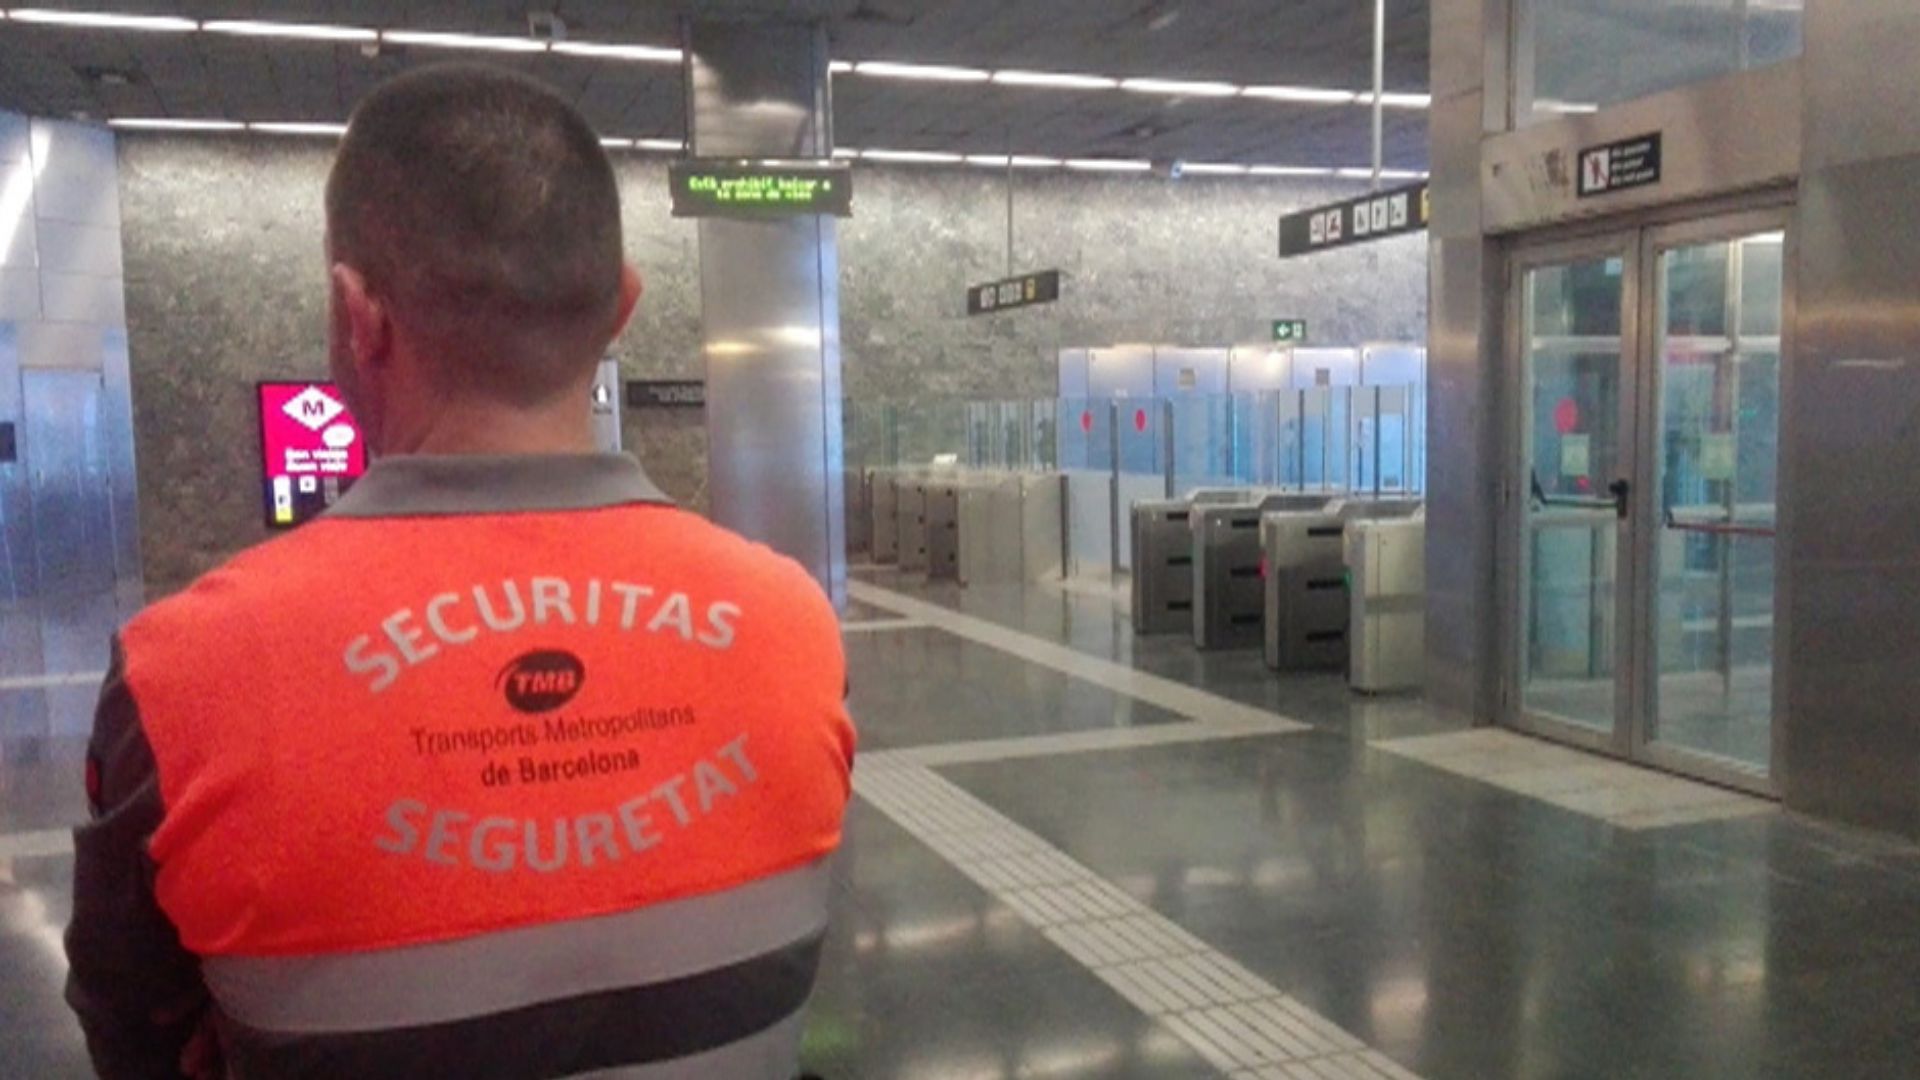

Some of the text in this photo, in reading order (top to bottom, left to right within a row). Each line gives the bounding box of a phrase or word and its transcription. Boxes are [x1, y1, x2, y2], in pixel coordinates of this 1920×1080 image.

[302, 399, 325, 416] M
[343, 576, 742, 693] SECURITAS
[515, 670, 576, 696] TMB
[411, 704, 697, 754] Transports Metropolitans
[481, 747, 641, 787] de Barcelona
[374, 732, 760, 872] SEGURETAT
